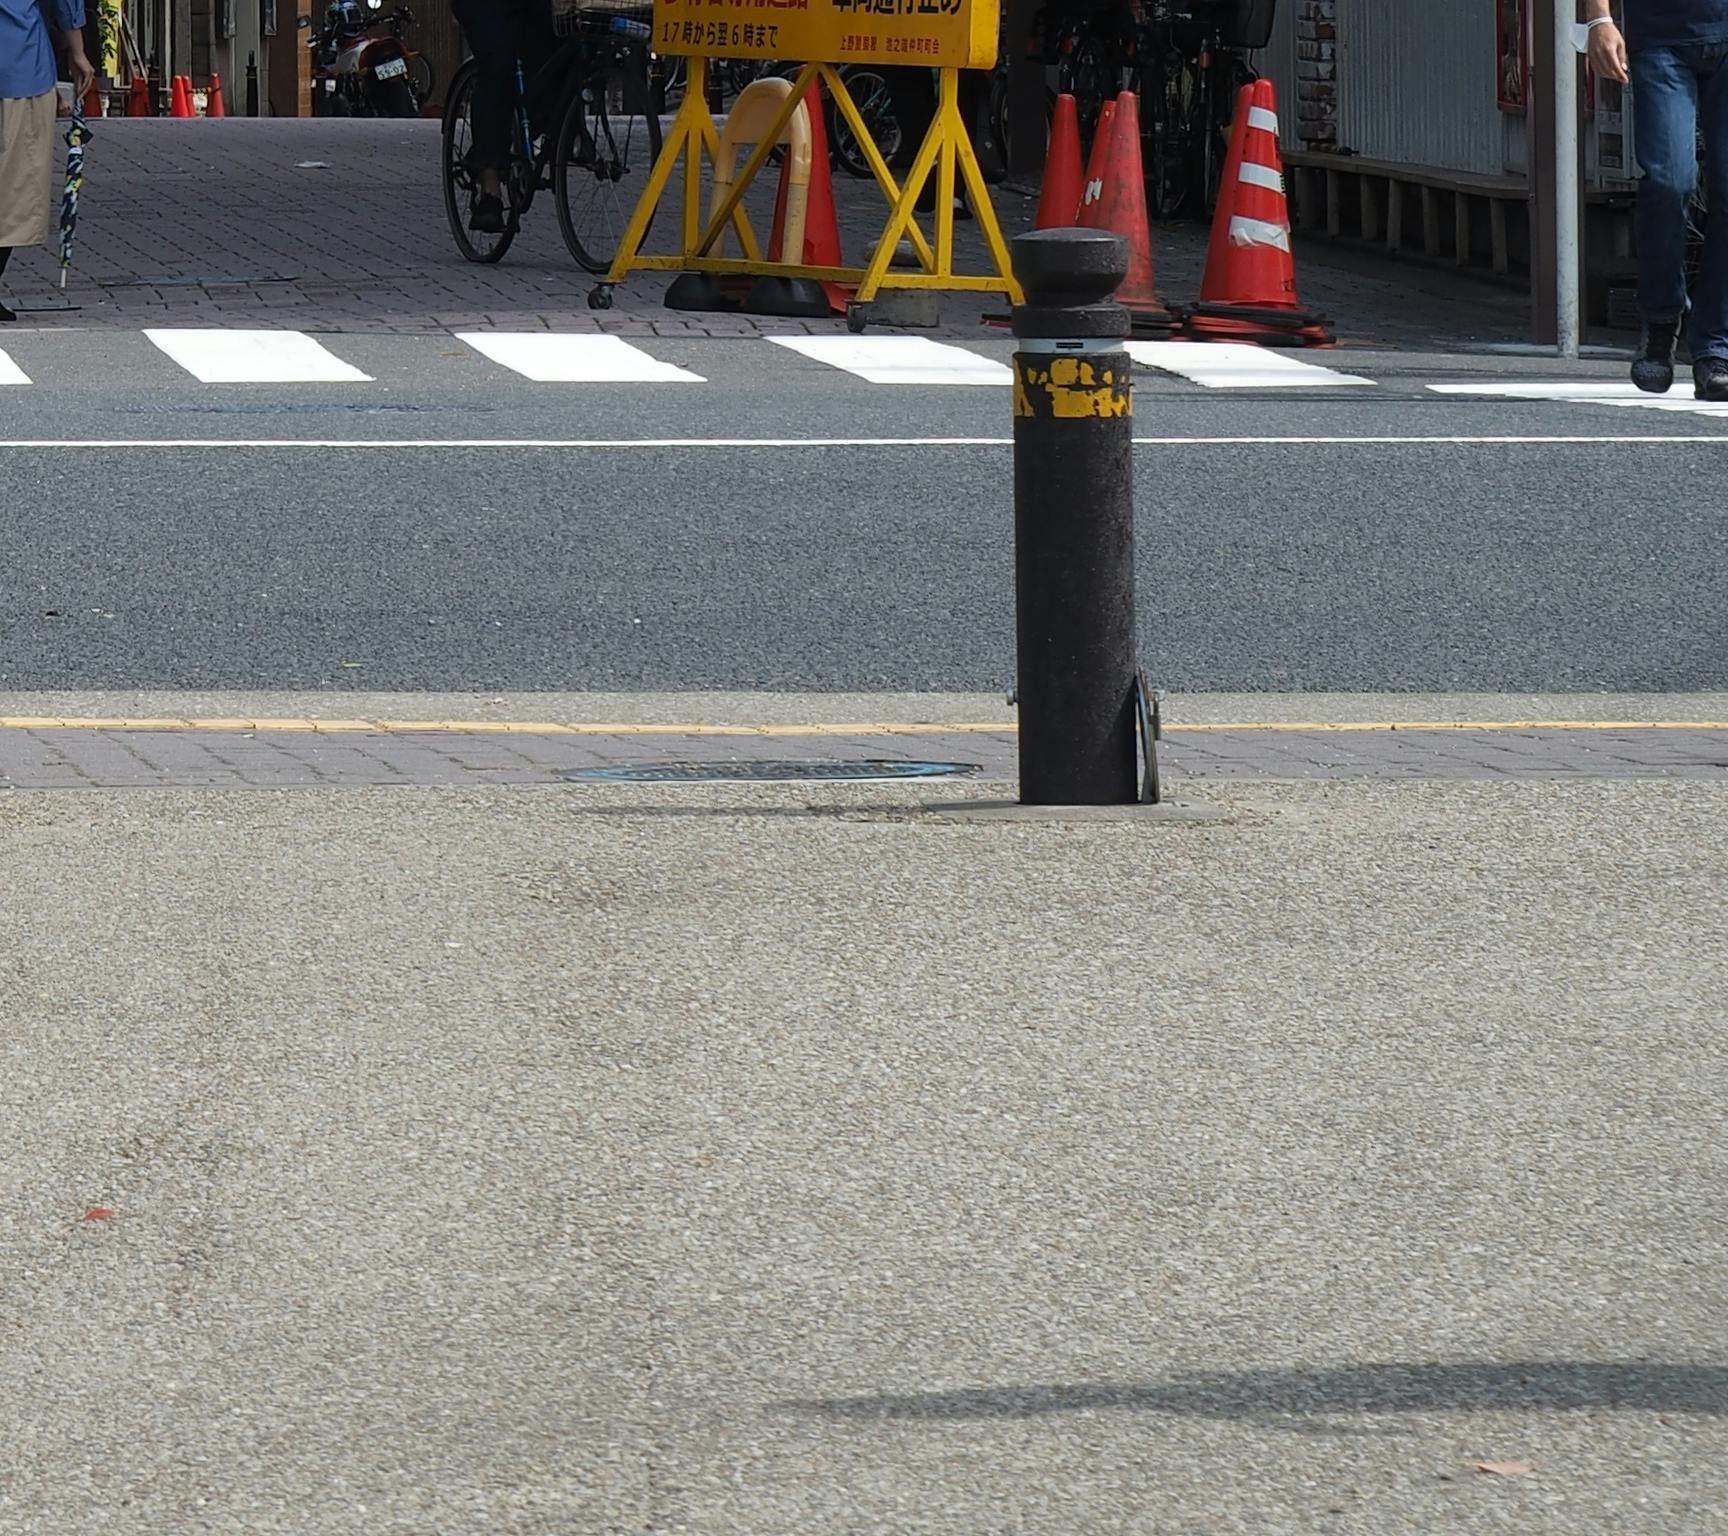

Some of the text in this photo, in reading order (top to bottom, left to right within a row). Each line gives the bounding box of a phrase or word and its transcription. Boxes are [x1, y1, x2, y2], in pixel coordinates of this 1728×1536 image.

[662, 21, 779, 49] 17時から翌6時まで
